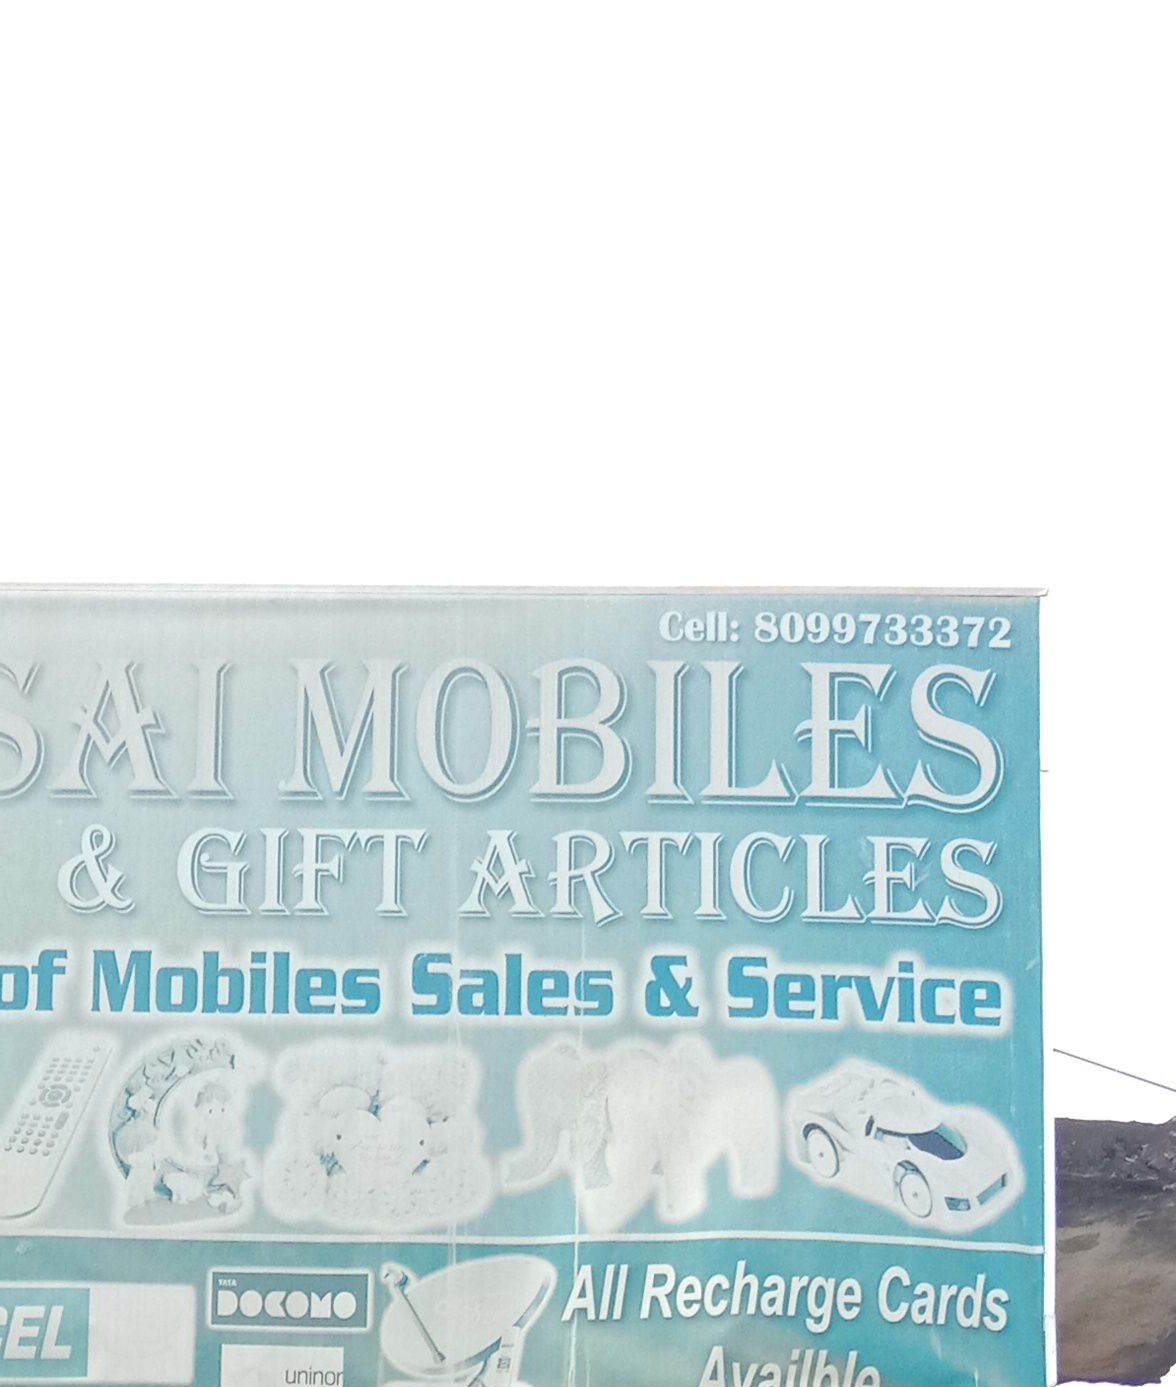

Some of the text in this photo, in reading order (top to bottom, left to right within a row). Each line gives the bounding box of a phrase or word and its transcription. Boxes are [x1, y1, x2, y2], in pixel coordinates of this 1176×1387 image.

[658, 610, 1012, 649] Cell: 8099733372
[278, 656, 1005, 815] MOBILES
[56, 823, 1004, 930] & GIFT ARTICLES
[90, 950, 382, 1016] Mobiles
[411, 953, 614, 1018] Sales
[645, 954, 700, 1019] &
[726, 956, 1004, 1028] Service
[216, 1288, 358, 1320] DOCOMO
[561, 1260, 1011, 1335] All Recharge Cards
[284, 1366, 344, 1387] uninor
